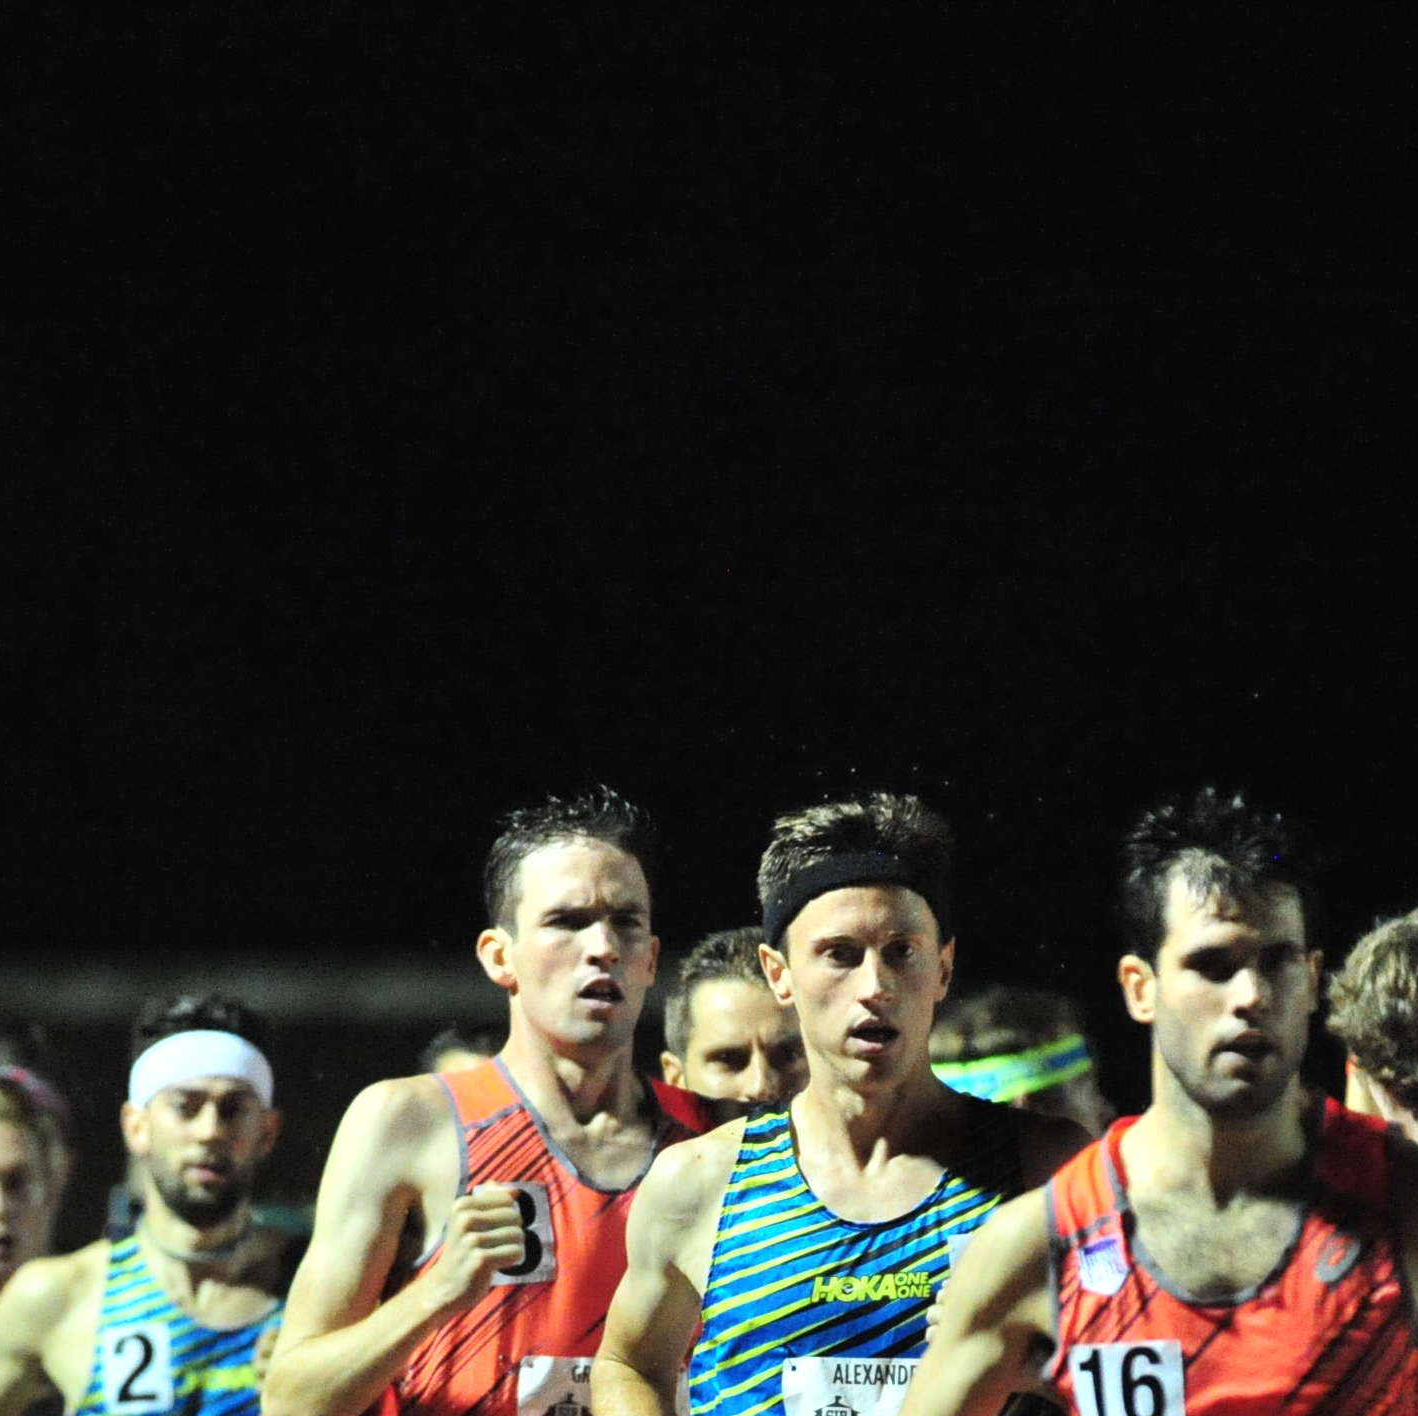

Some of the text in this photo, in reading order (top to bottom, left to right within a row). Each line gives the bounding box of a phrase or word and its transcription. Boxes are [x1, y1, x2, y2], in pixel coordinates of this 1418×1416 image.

[812, 1272, 931, 1302] HOKA ONE ONE
[115, 1335, 157, 1402] 2
